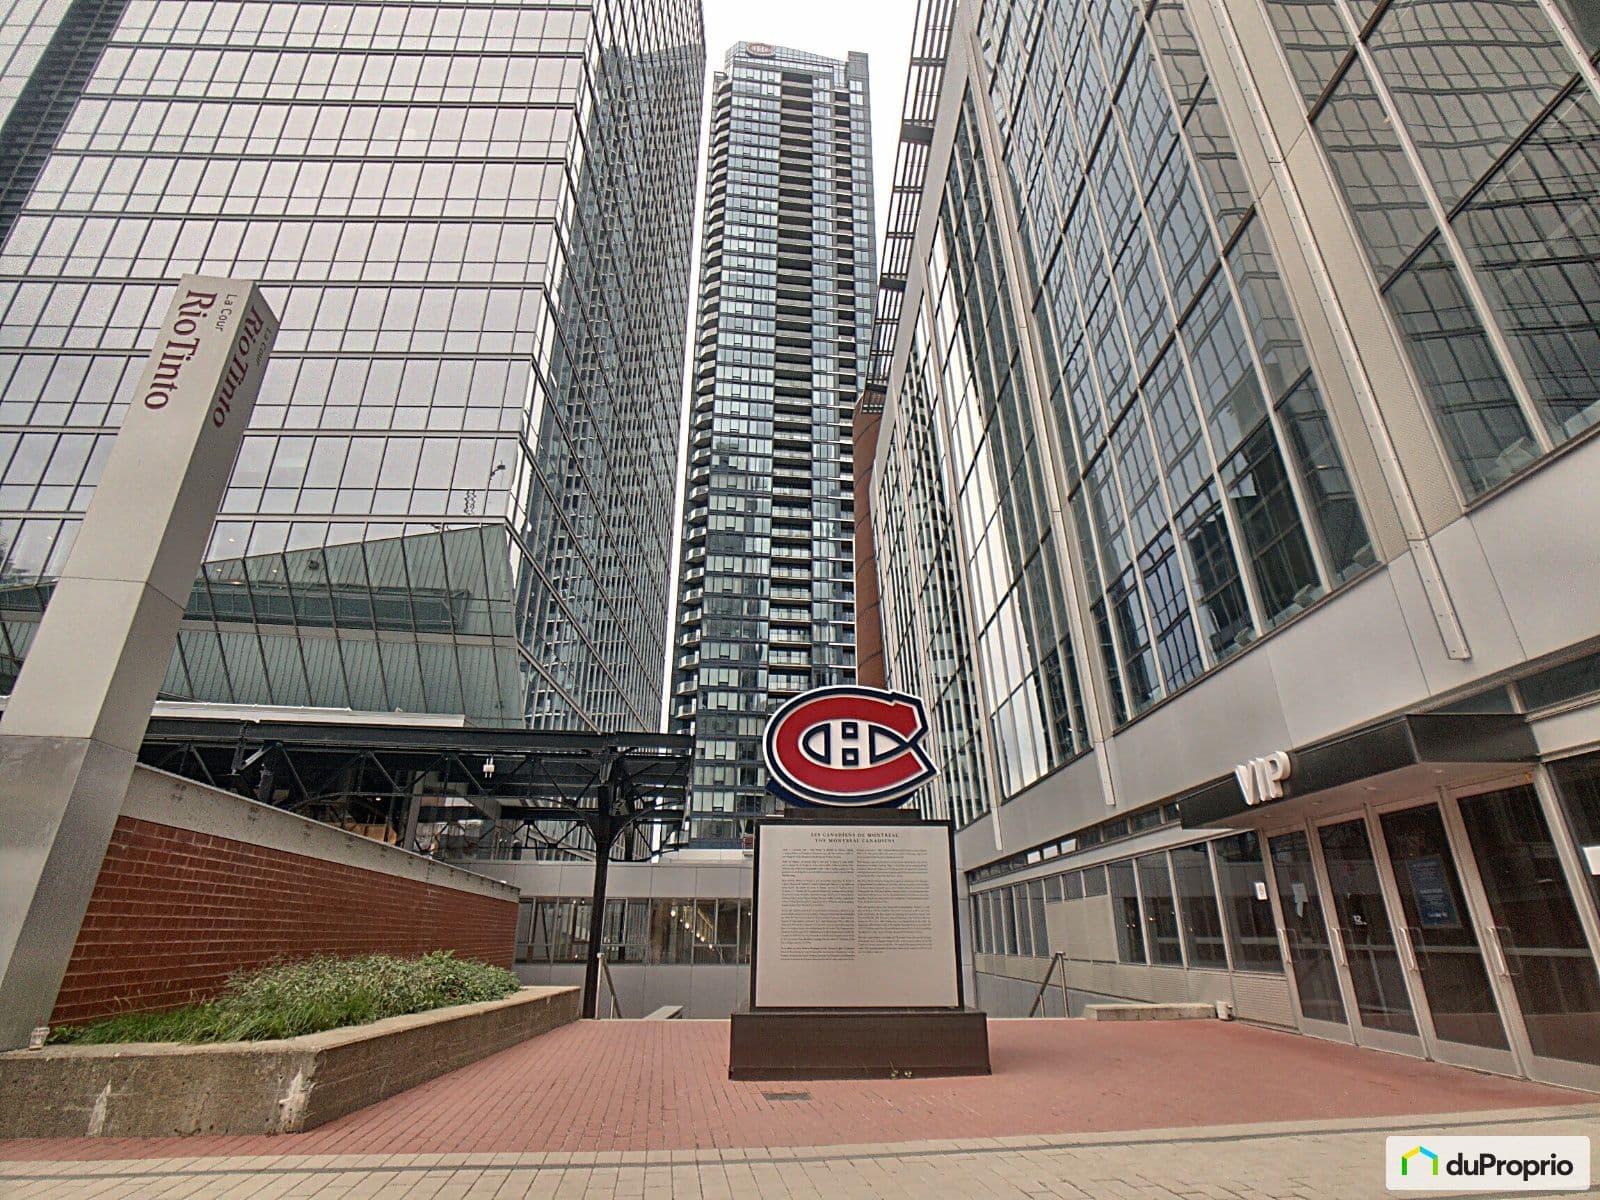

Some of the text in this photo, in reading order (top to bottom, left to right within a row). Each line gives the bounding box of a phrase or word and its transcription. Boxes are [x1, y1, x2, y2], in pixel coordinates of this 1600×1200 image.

[215, 293, 238, 332] La Cour
[1234, 750, 1292, 806] VIP
